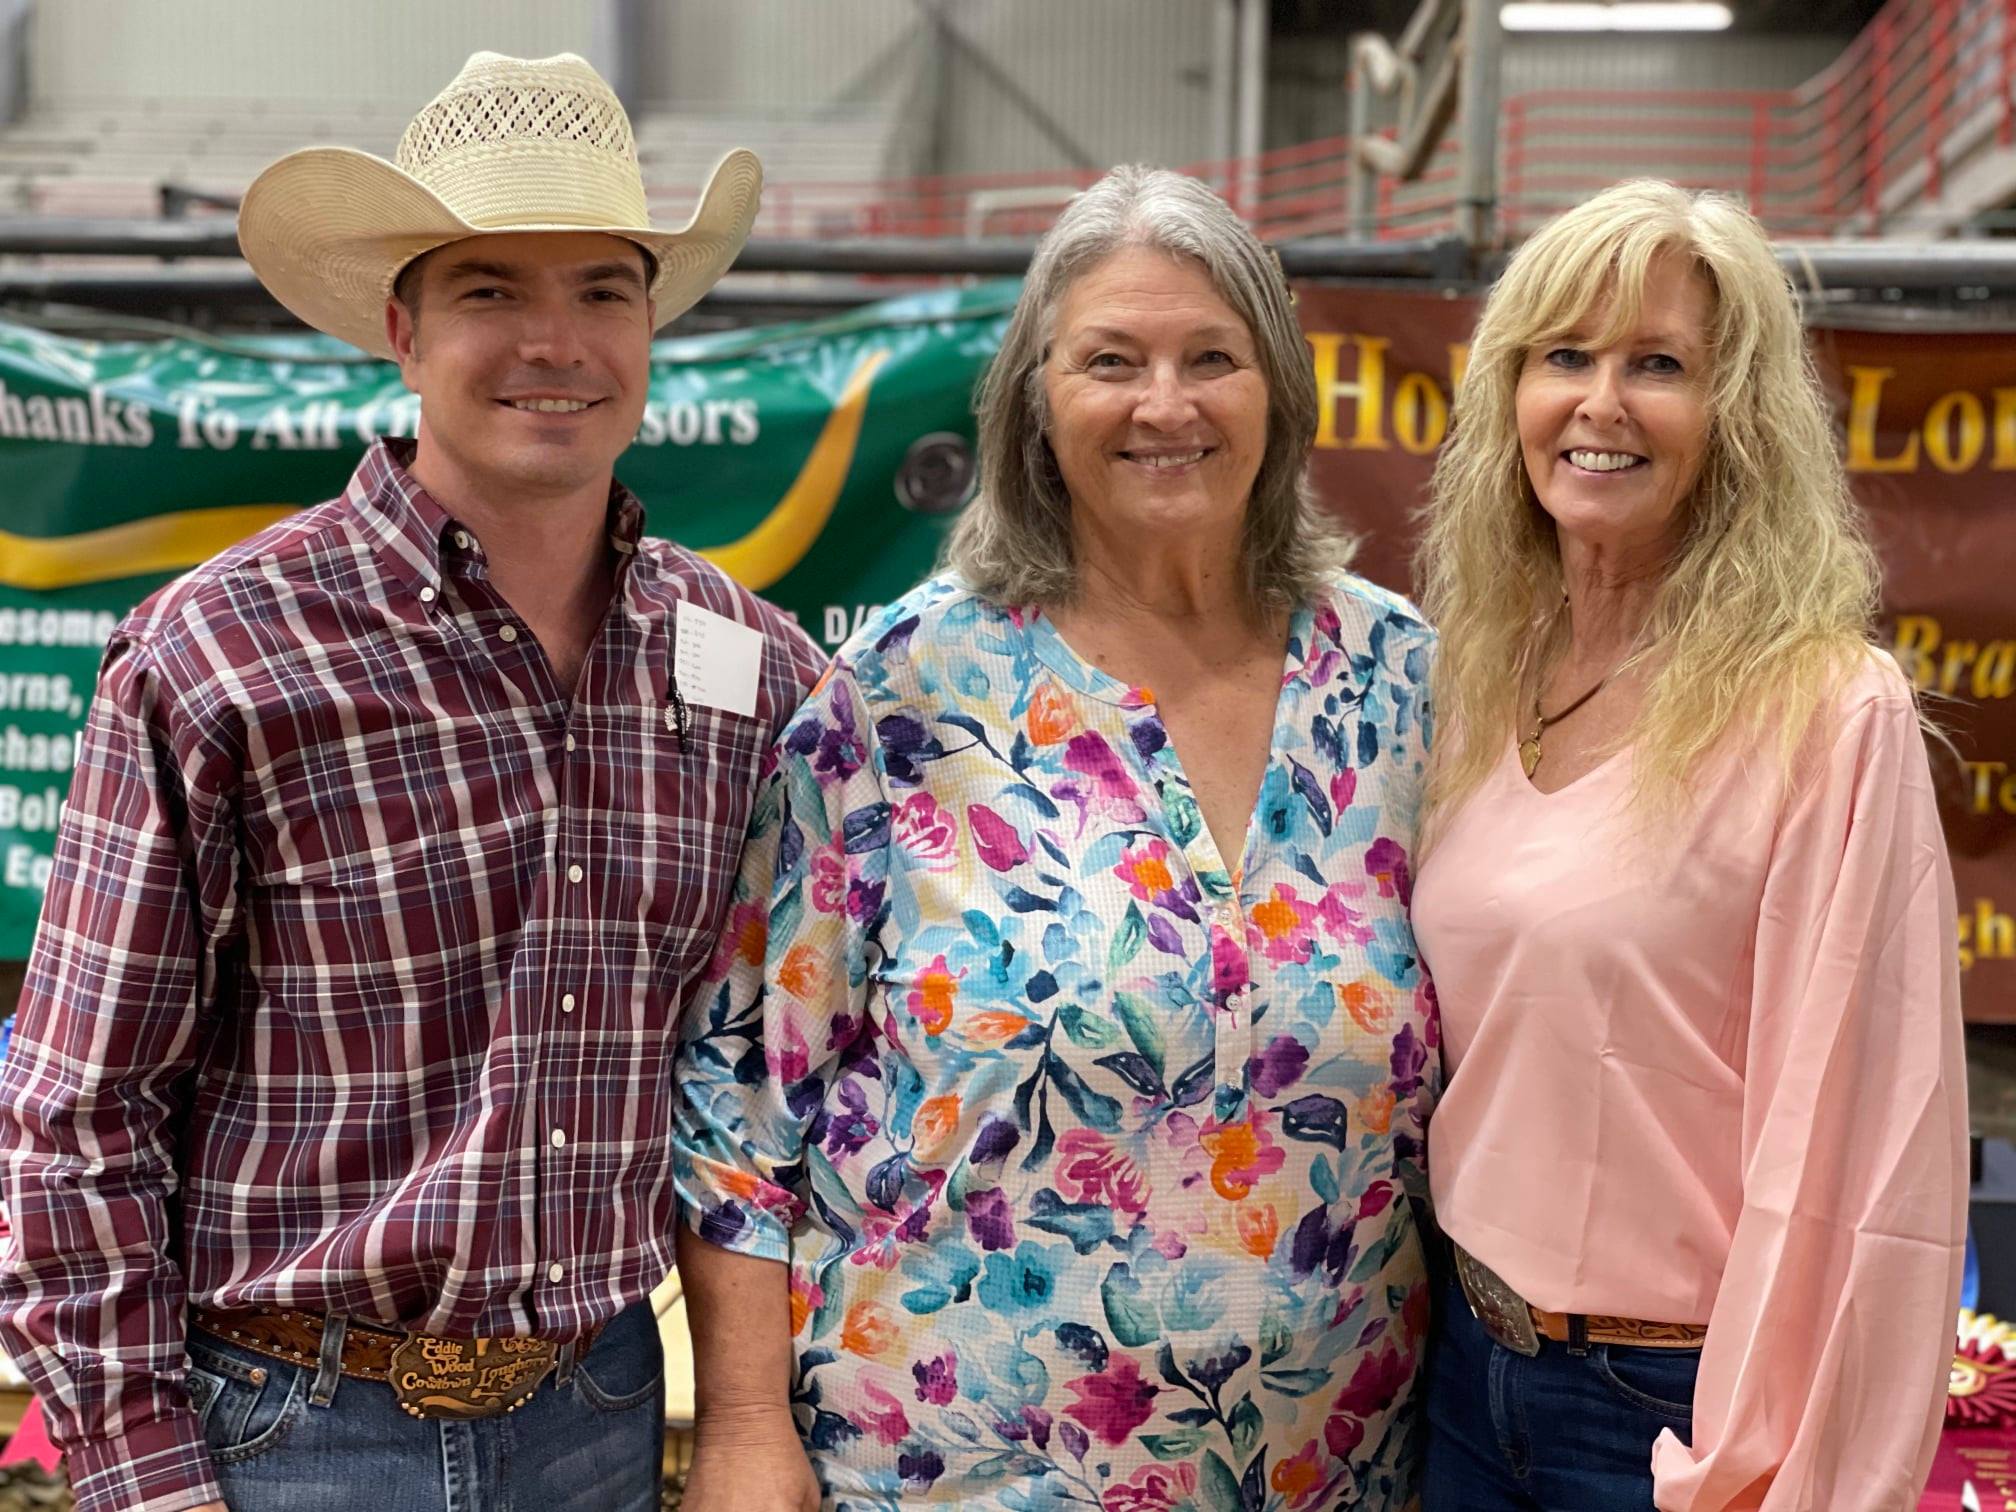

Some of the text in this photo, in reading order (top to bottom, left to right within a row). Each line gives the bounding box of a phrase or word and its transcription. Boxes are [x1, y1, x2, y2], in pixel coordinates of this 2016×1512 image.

[167, 390, 240, 450] To
[252, 401, 342, 450] All
[416, 1337, 463, 1357] Eddie
[426, 1354, 475, 1375] Wood
